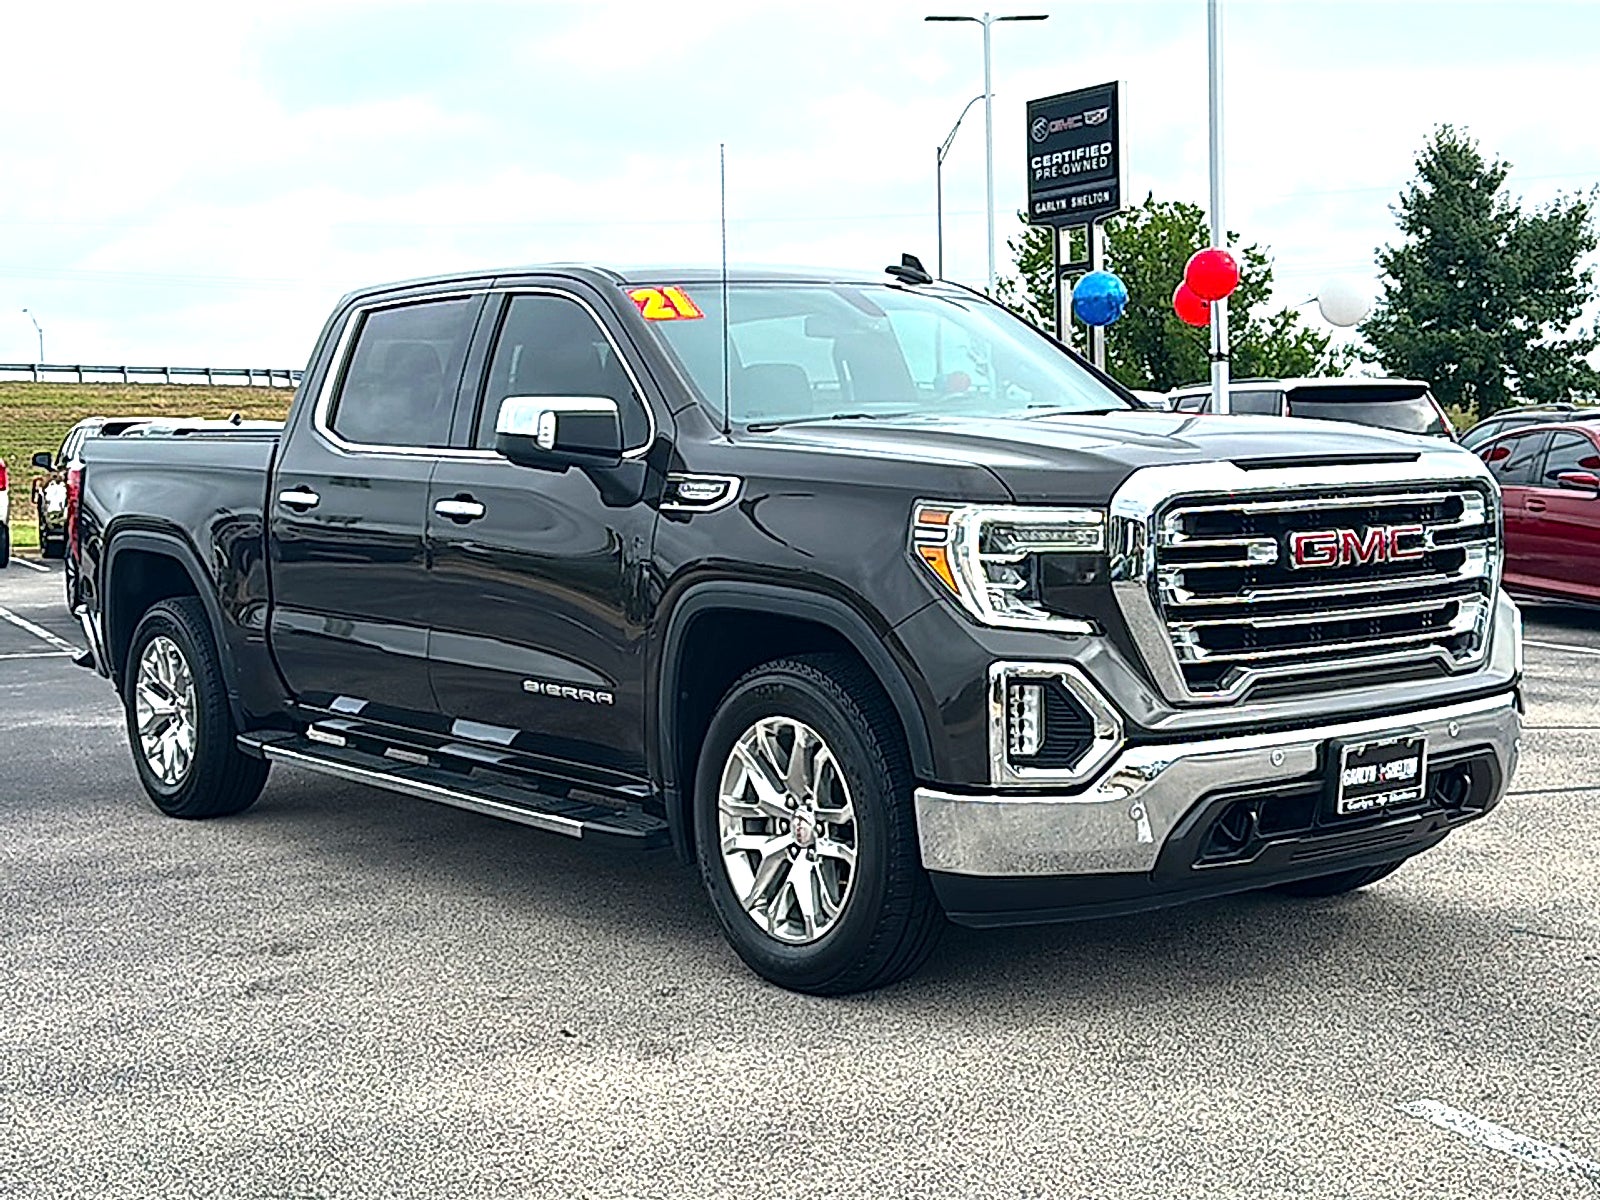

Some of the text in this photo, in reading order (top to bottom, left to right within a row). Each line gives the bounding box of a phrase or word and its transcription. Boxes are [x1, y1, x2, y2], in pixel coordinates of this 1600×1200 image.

[1031, 142, 1112, 169] CERTIFIED
[1035, 156, 1108, 181] PRE-OWNED
[1071, 191, 1110, 208] SHELTON
[627, 286, 703, 320] 21
[1290, 524, 1424, 569] GMC
[523, 680, 613, 705] SIERRA
